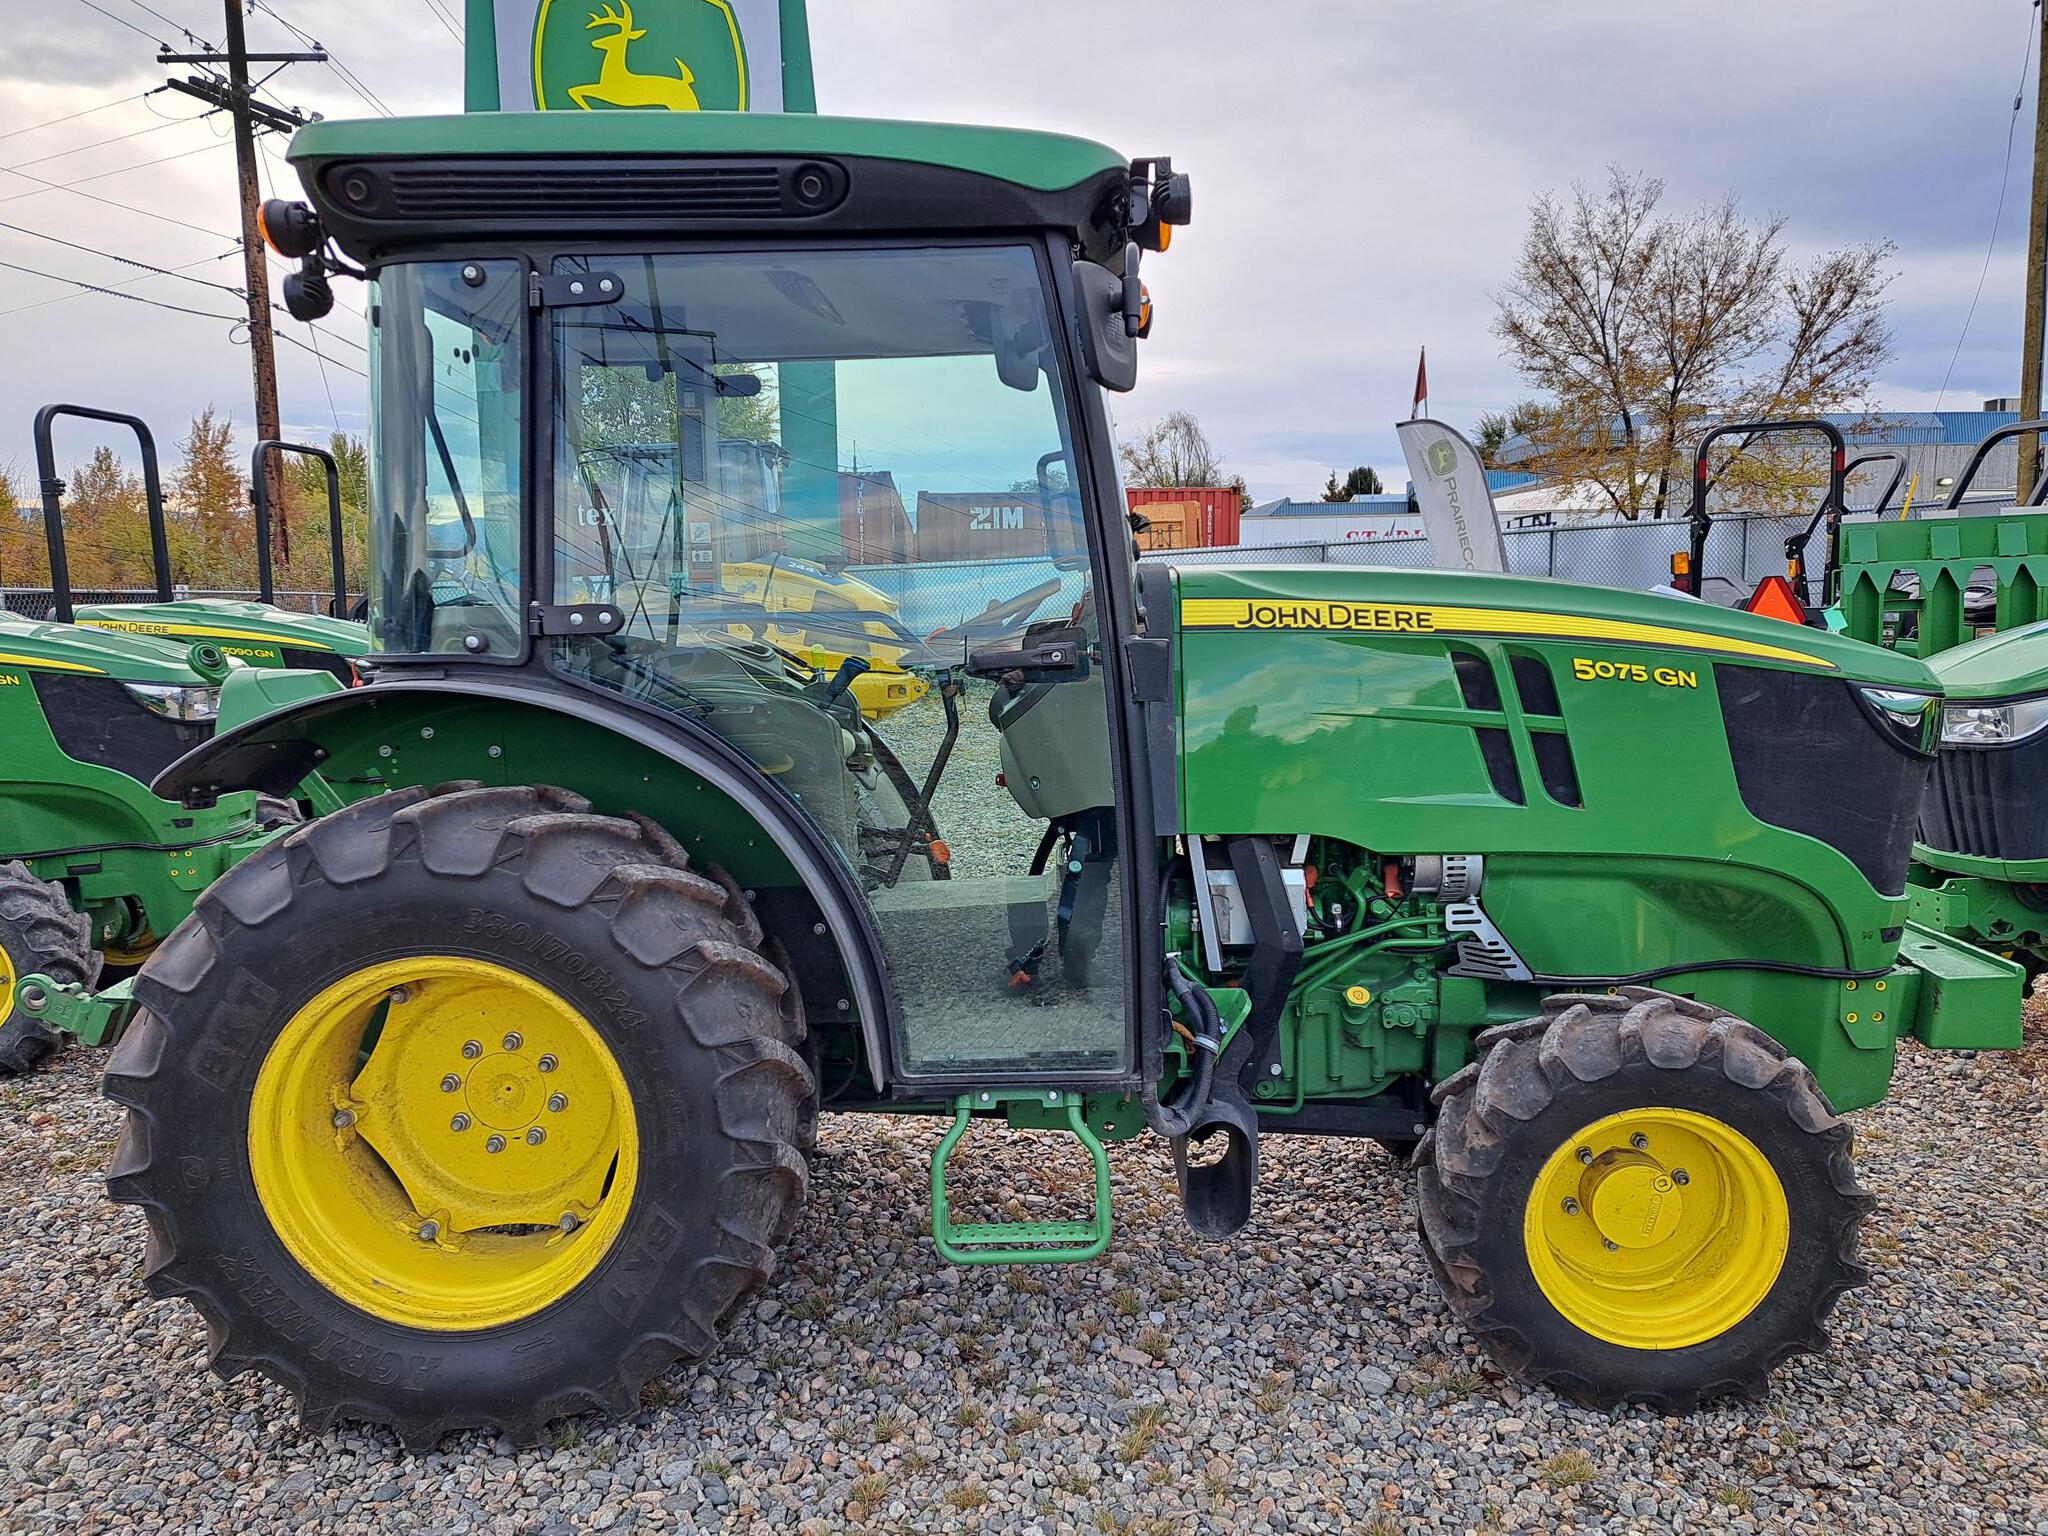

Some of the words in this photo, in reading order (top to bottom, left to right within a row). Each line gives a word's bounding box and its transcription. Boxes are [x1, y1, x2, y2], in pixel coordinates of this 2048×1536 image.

[969, 506, 1024, 530] ZIM
[98, 621, 127, 632] JOHN
[128, 622, 169, 634] DEERE
[1237, 602, 1321, 626] JOHN
[1328, 604, 1434, 629] DEERE
[221, 646, 253, 657] 5090
[255, 649, 275, 658] GN
[1573, 658, 1648, 682] 5075
[1653, 667, 1697, 689] GN
